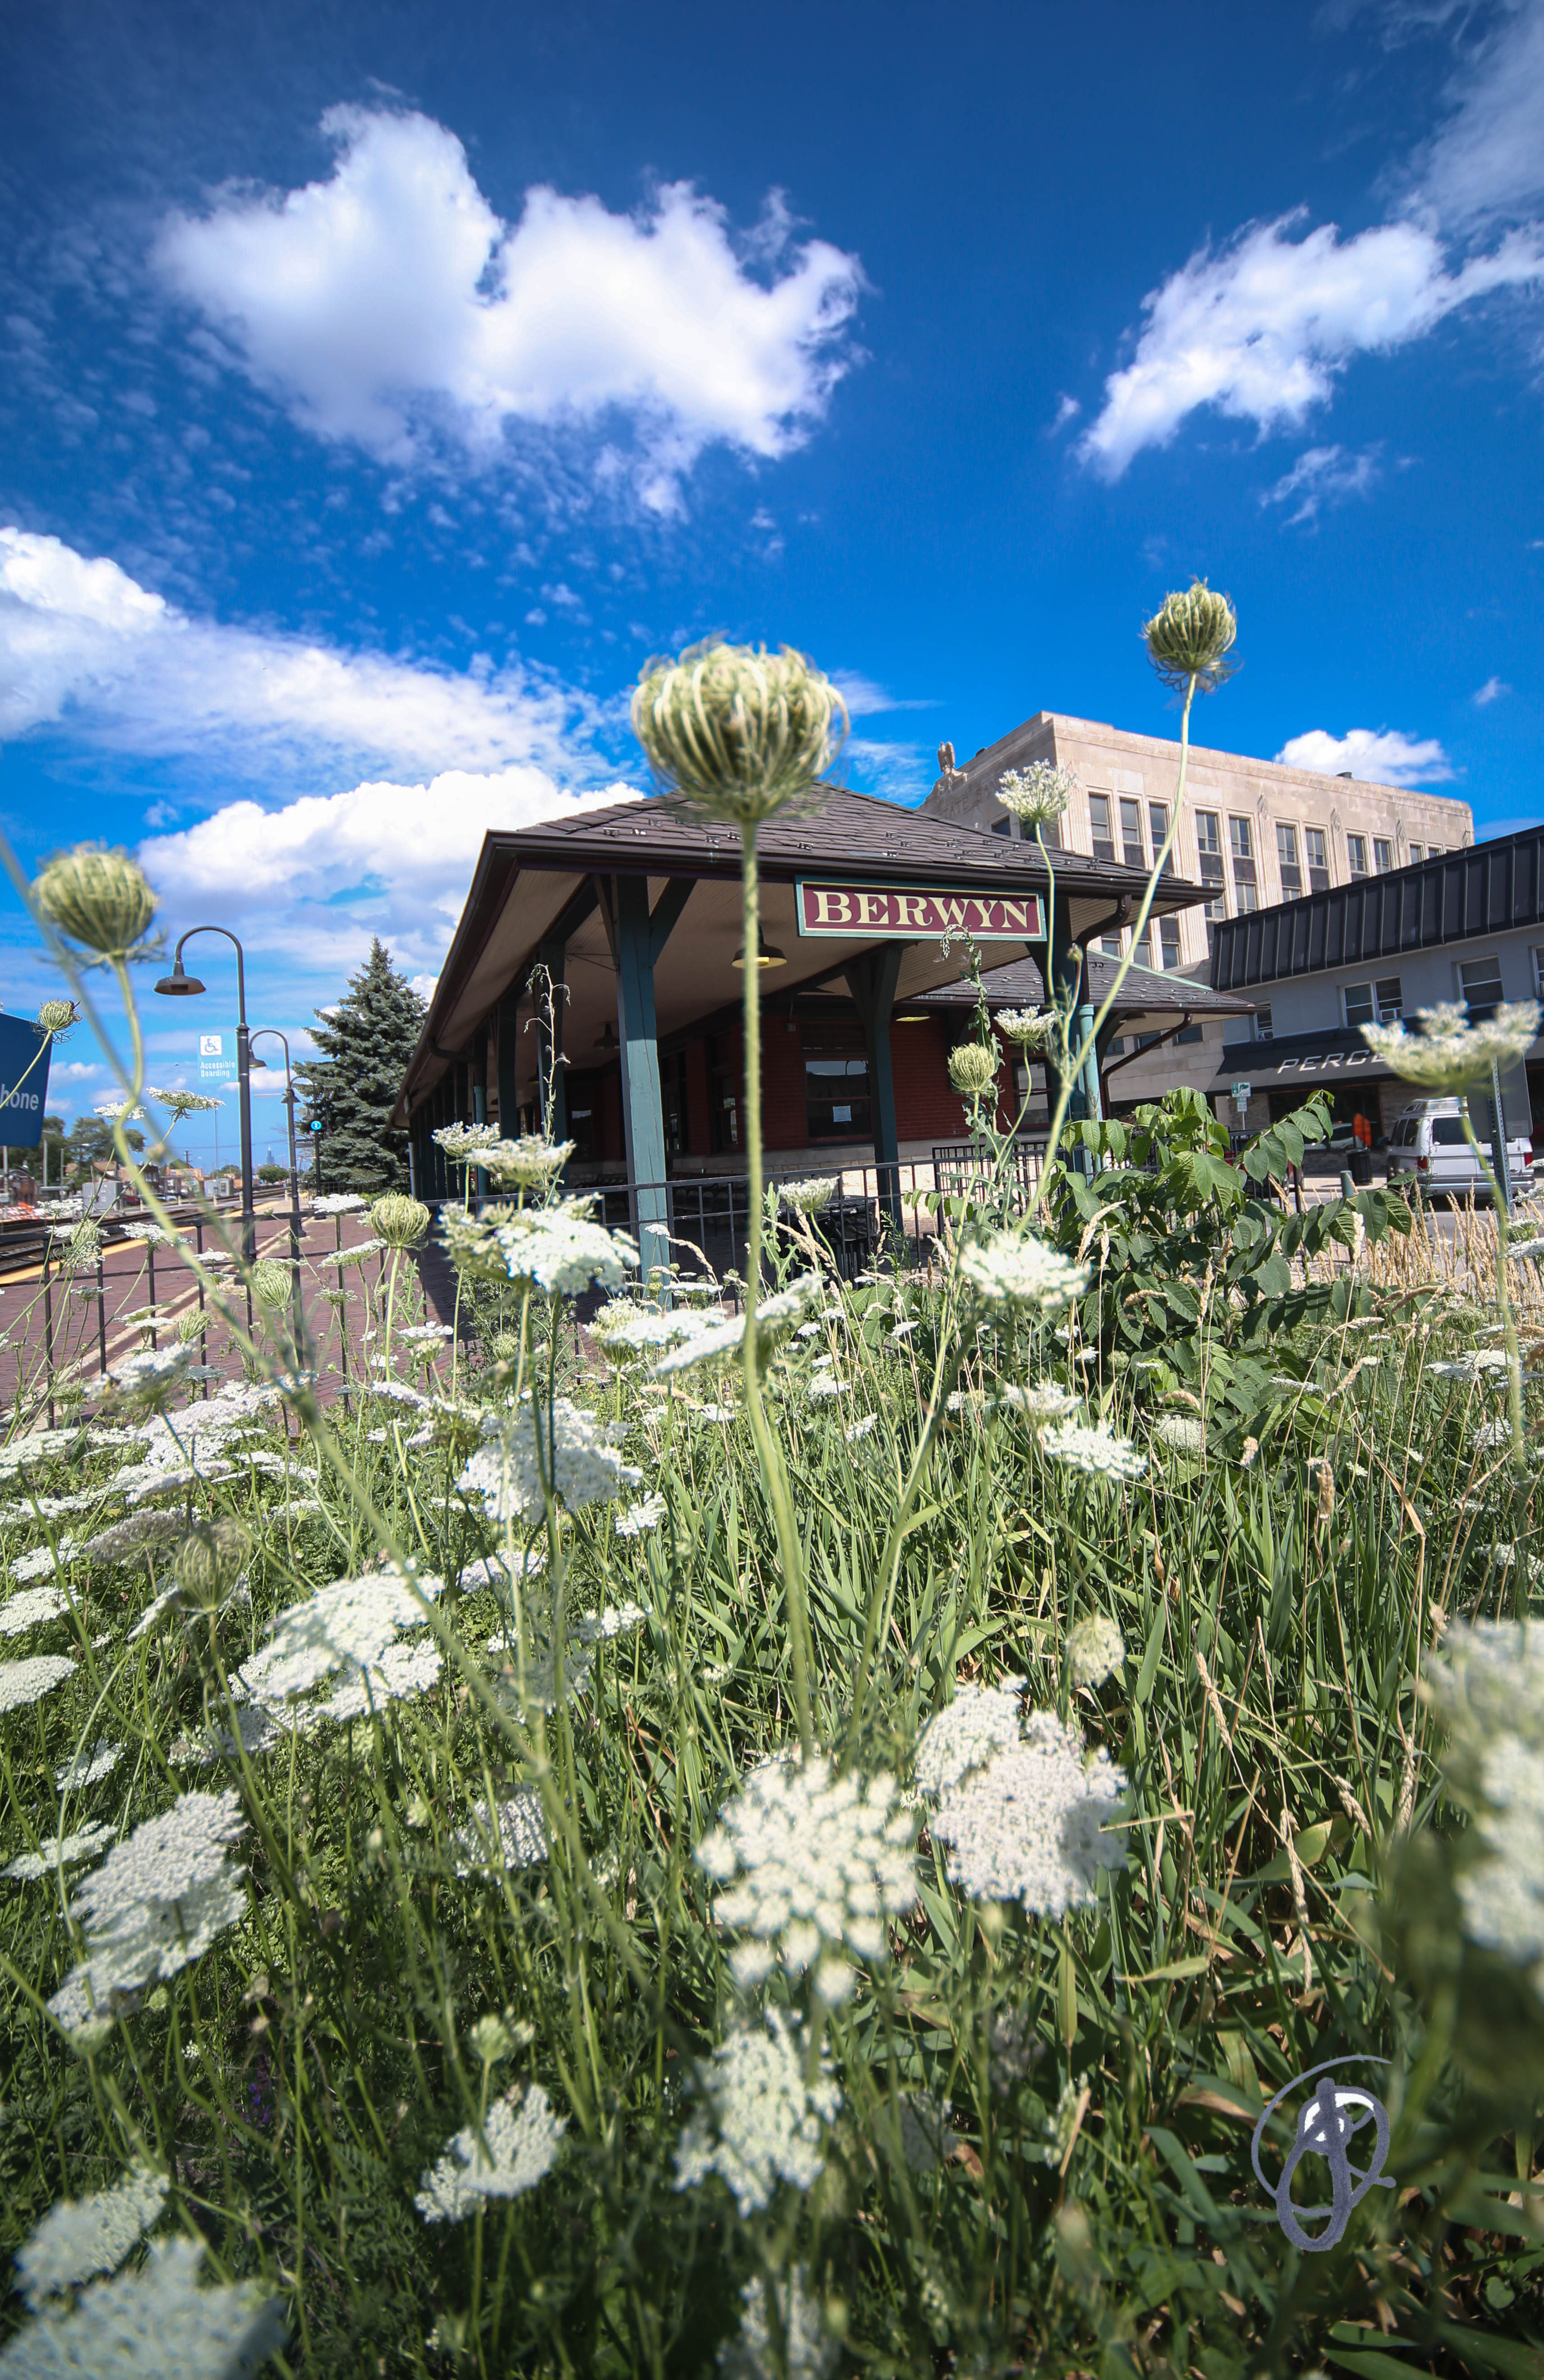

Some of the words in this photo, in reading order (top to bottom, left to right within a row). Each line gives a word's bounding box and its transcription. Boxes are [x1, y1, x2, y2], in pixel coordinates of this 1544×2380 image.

[813, 891, 1029, 928] BERWYN
[200, 1061, 235, 1069] Accessible
[200, 1069, 230, 1077] Boarding
[0, 1083, 39, 1110] hone
